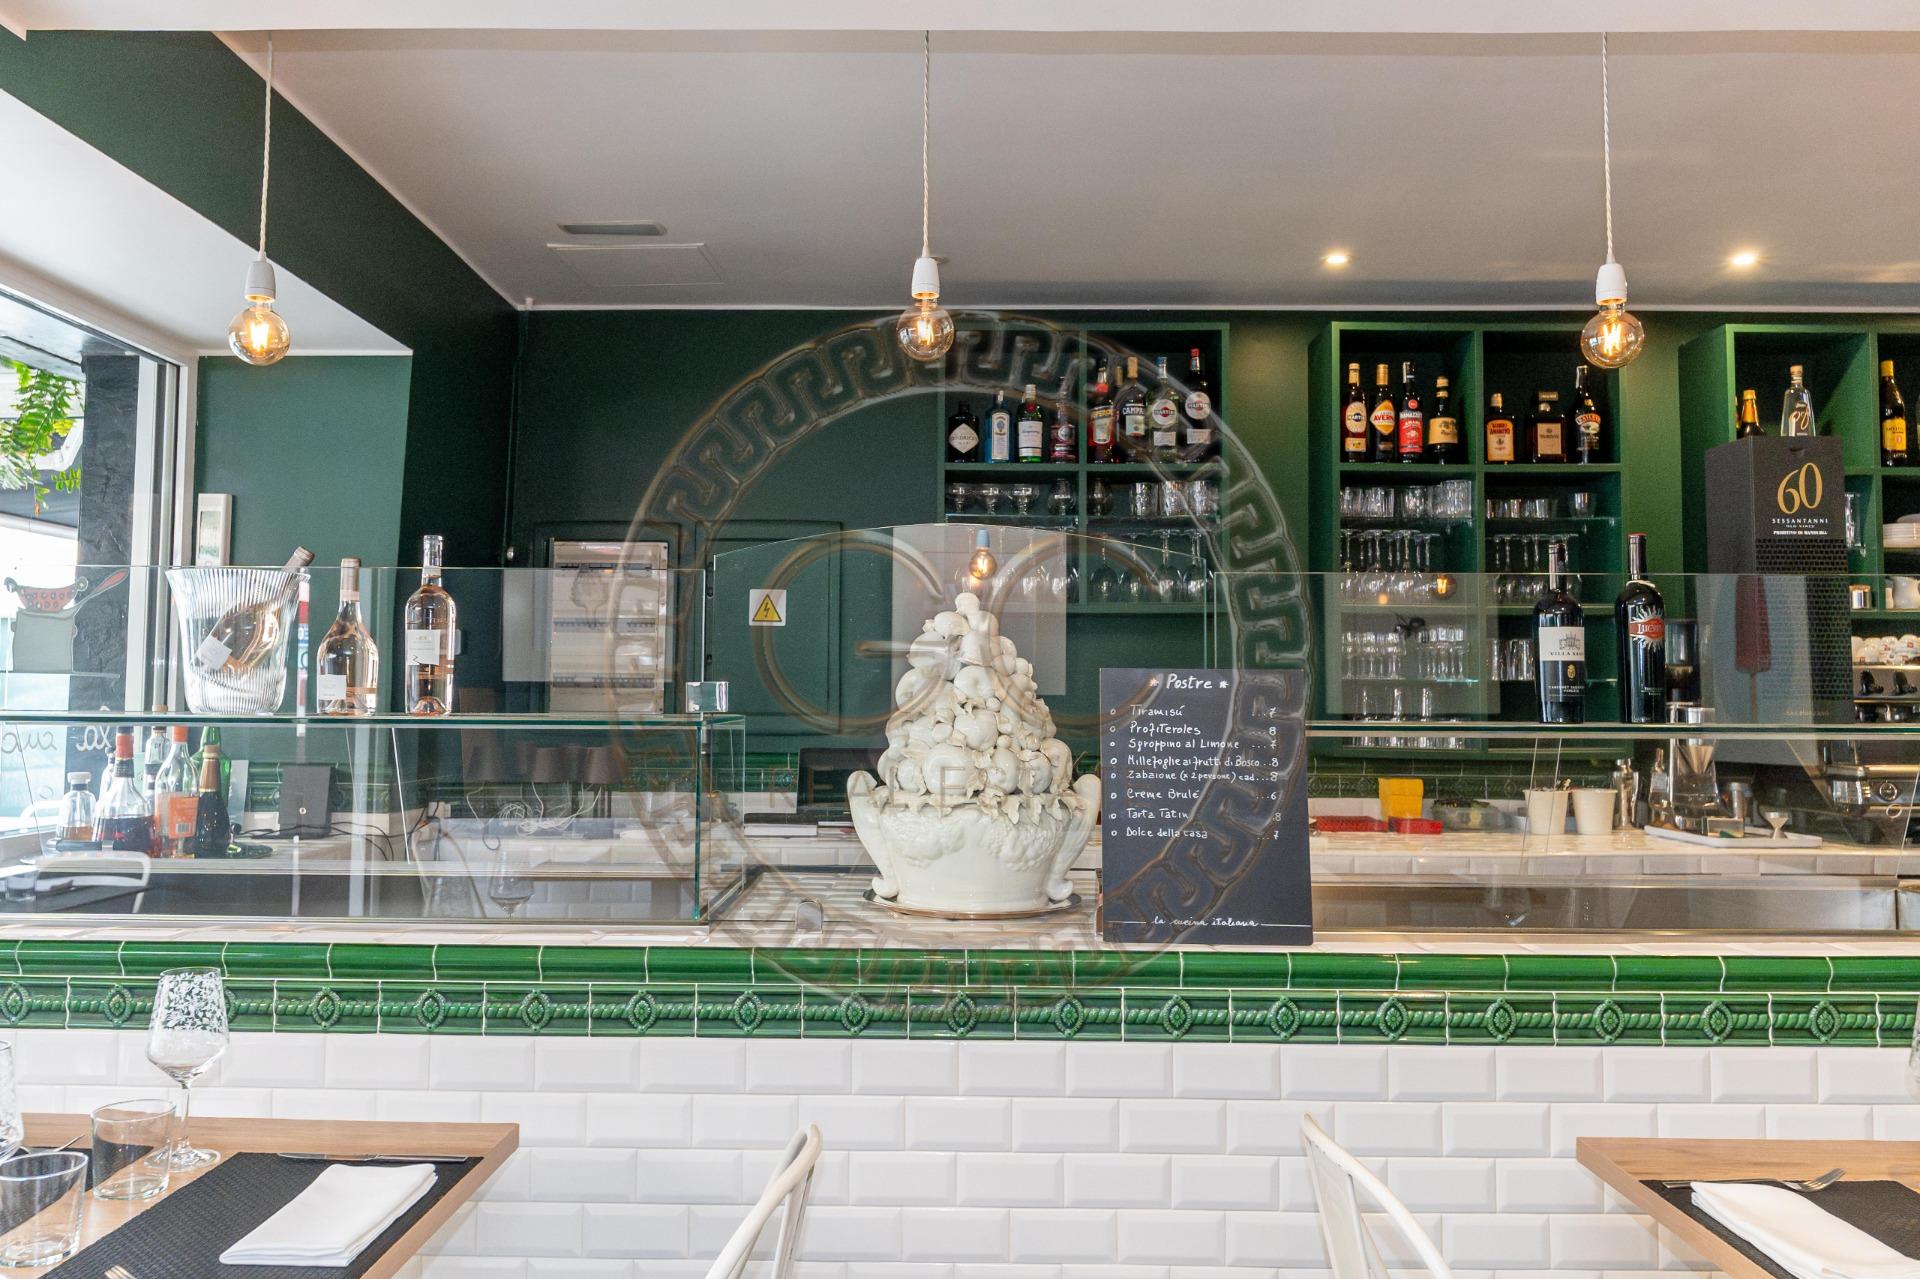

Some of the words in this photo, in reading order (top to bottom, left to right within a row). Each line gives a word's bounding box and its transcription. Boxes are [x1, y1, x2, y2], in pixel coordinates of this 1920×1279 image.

[1777, 462, 1823, 515] 60
[1166, 673, 1213, 689] Postre
[1130, 704, 1185, 716] Tiramisú
[1128, 738, 1181, 752] Sgroppino
[1184, 739, 1196, 748] al
[1200, 738, 1240, 749] Limone
[1127, 755, 1180, 769] Millefoglie
[1193, 756, 1221, 770] frutti
[1224, 756, 1234, 767] di
[1234, 755, 1260, 767] Bosco
[1127, 770, 1177, 780] Zabaione
[1126, 789, 1163, 799] Creme
[1168, 789, 1200, 799] Brulé
[1126, 807, 1155, 819] Tarta
[1159, 807, 1189, 819] Tatin
[1126, 826, 1153, 837] Dolce
[1157, 826, 1181, 838] della
[1183, 829, 1208, 839] casa
[1151, 915, 1166, 924] la
